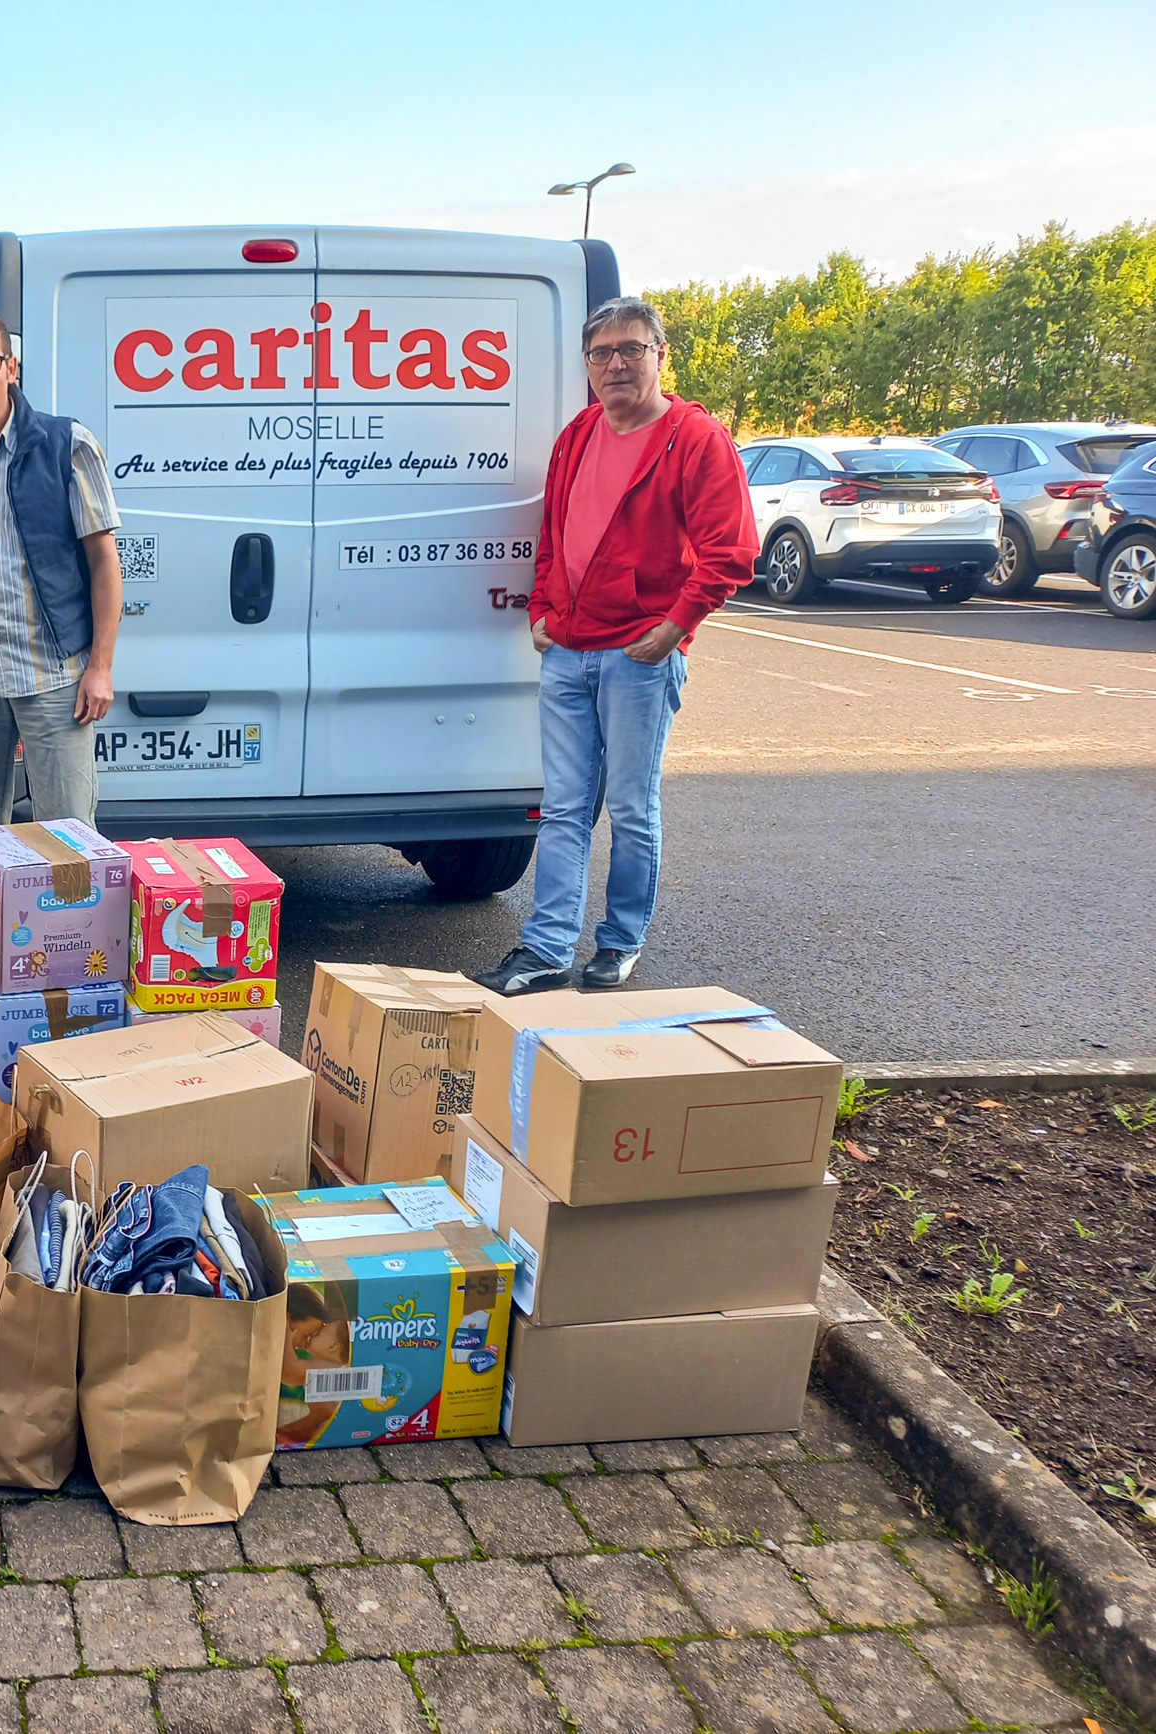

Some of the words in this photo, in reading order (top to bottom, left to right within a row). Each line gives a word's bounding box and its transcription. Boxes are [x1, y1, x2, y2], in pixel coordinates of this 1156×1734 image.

[113, 302, 511, 392] caritas
[248, 415, 384, 440] MOSELLE
[114, 454, 154, 480] Au
[162, 456, 228, 472] service
[234, 452, 266, 472] des
[269, 452, 312, 480] plus
[316, 451, 393, 480] fragiles
[398, 451, 458, 478] depuis
[466, 452, 508, 470] 1906
[344, 546, 374, 564] Tél
[398, 545, 421, 562] 03
[427, 544, 450, 561] 87
[456, 543, 478, 560] 36
[484, 542, 505, 560] 83
[512, 541, 532, 559] 58
[244, 744, 260, 758] 57
[109, 870, 123, 880] 76
[44, 932, 84, 942] Premium-
[44, 940, 92, 953] Windeln
[154, 992, 195, 1005] PACK
[200, 991, 240, 1003] MEGA
[100, 1004, 115, 1013] 72
[175, 1076, 206, 1088] W2
[320, 1068, 360, 1105] Demenagement
[613, 1126, 656, 1163] 13
[350, 1316, 436, 1346] Pampers
[390, 1417, 403, 1426] 82
[411, 1409, 430, 1428] 4
